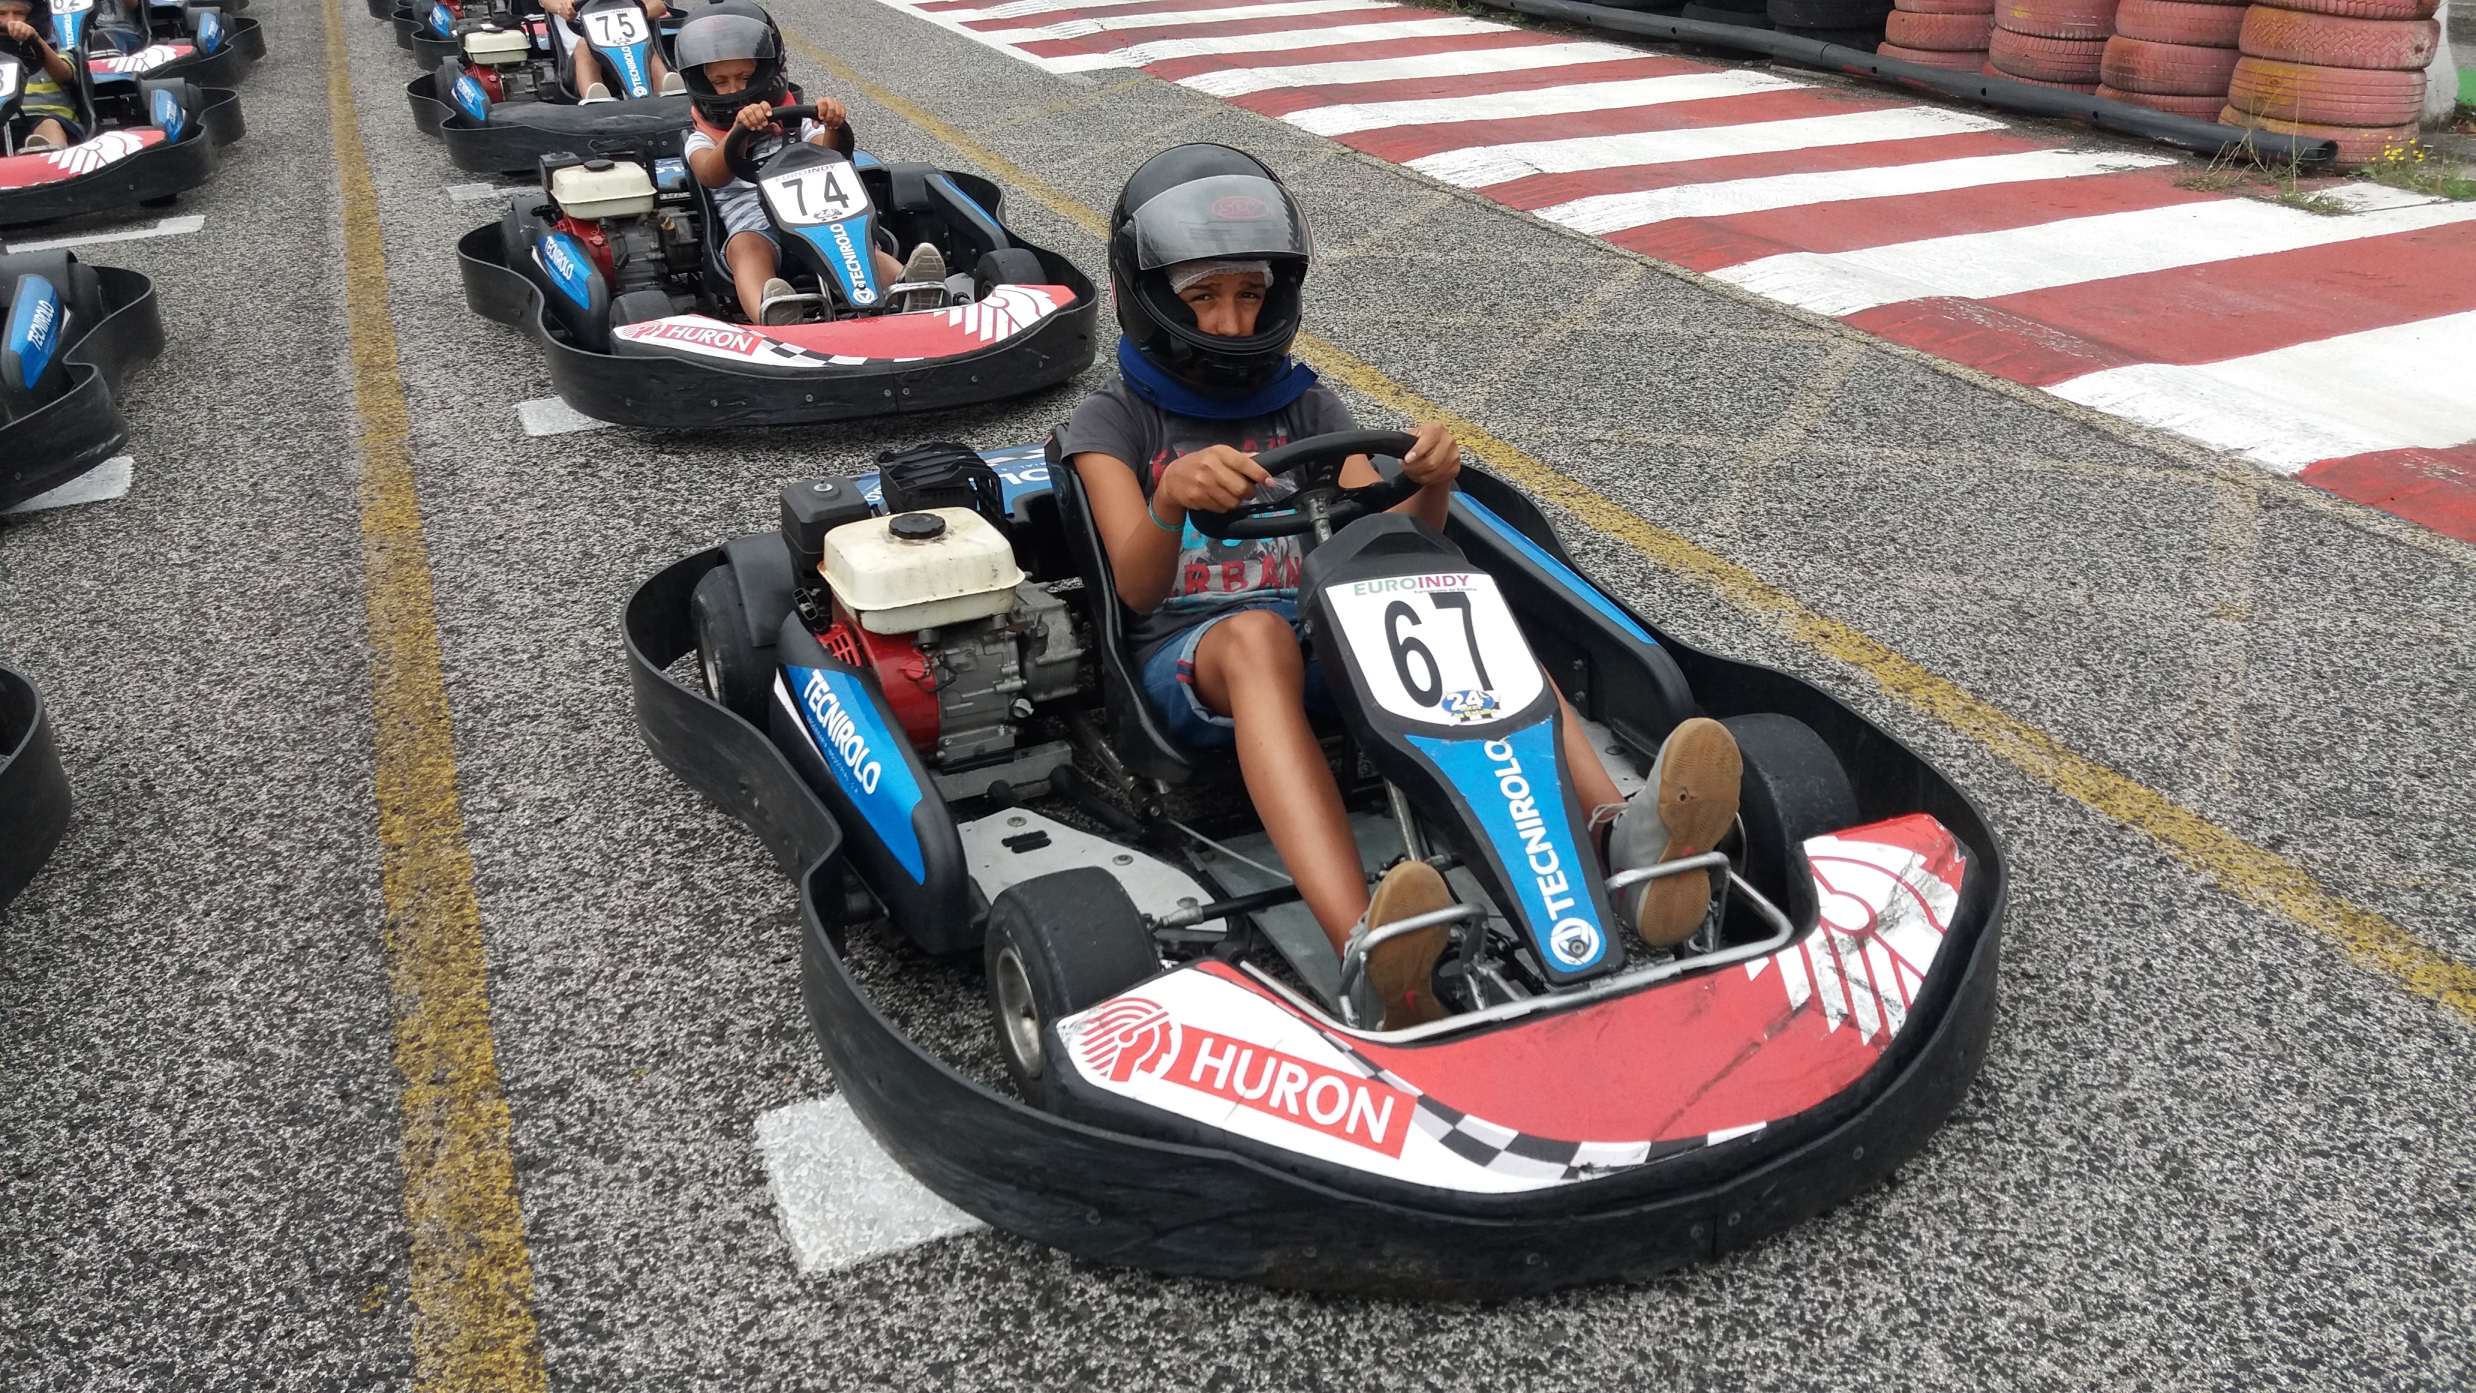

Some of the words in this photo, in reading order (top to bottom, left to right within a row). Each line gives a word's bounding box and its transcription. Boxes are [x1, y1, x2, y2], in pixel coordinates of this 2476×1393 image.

[595, 12, 635, 41] 75
[781, 171, 850, 216] 74
[544, 236, 574, 280] TECNIROLO
[829, 223, 867, 288] TECNIROLO
[27, 300, 55, 351] TECNIROLO
[667, 326, 753, 352] HURON
[1168, 554, 1301, 598] RBAN
[1354, 575, 1469, 596] EUROINDY
[1385, 592, 1494, 708] 67
[1447, 690, 1484, 711] 24
[803, 668, 882, 795] TECNIROLO
[1484, 740, 1575, 920] TECNIROLO
[1190, 1037, 1395, 1144] HURON
